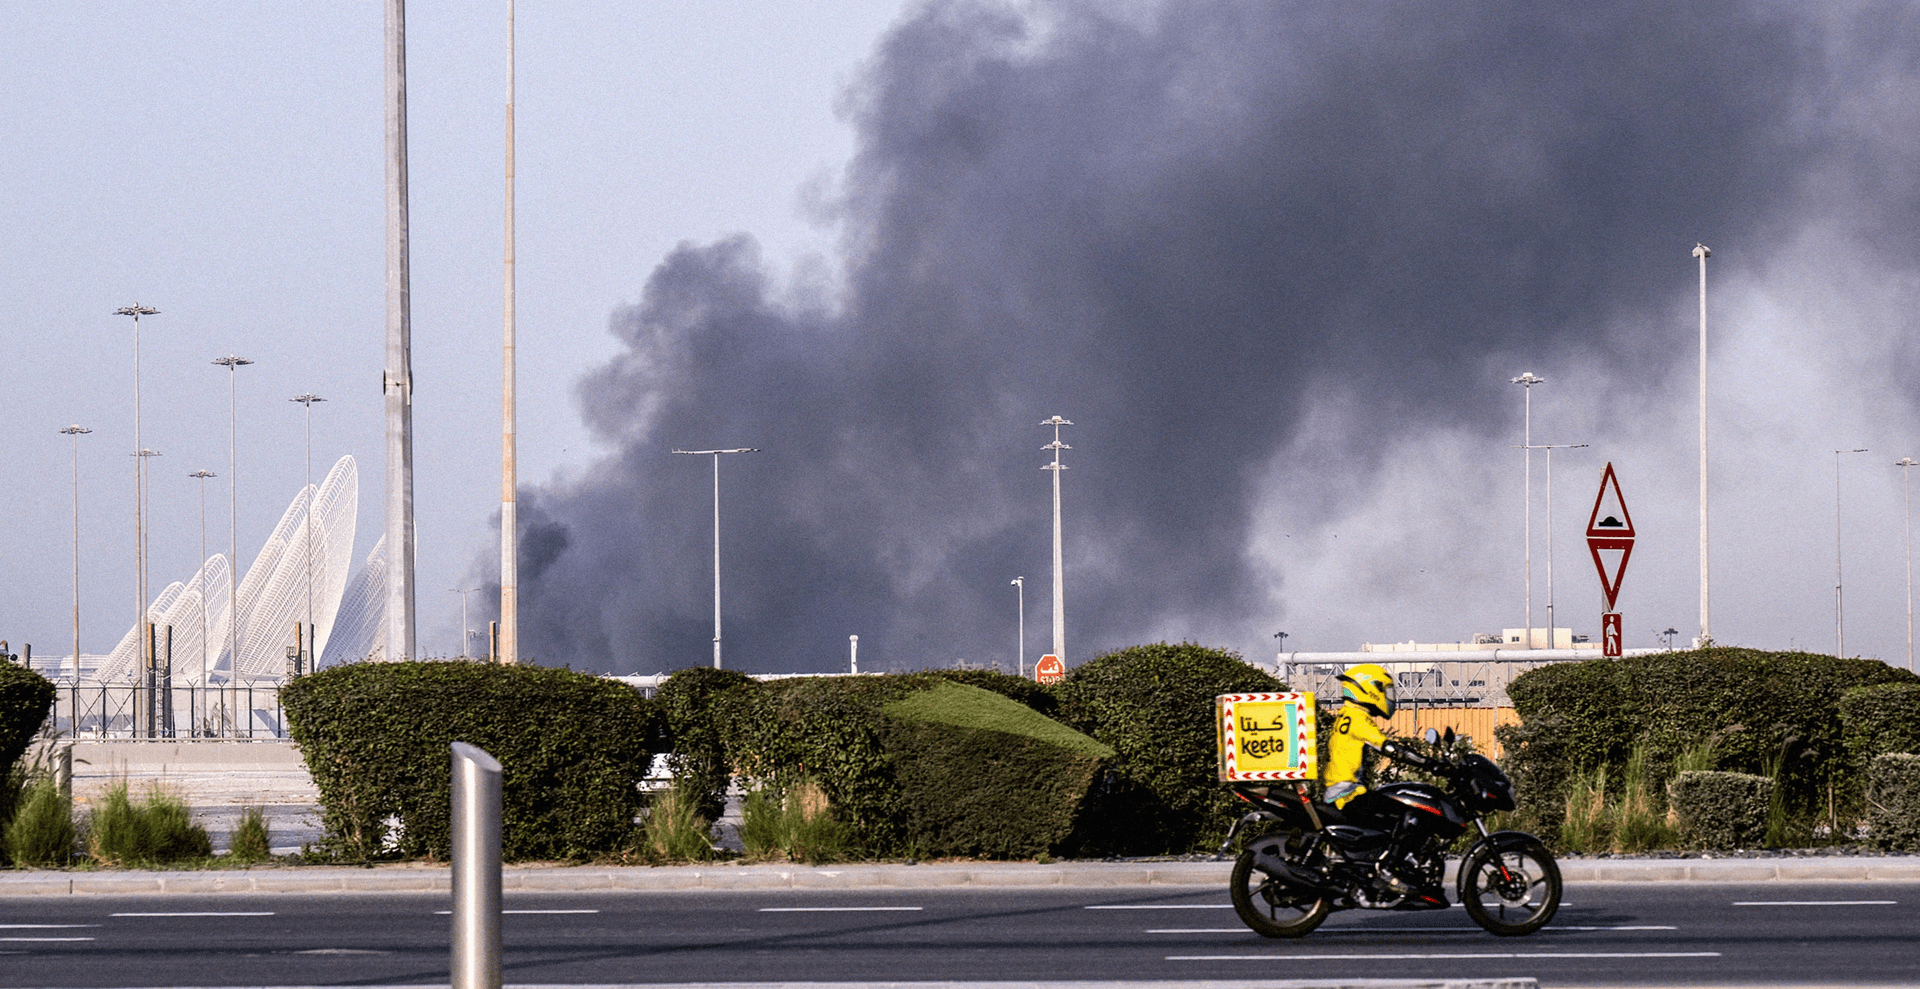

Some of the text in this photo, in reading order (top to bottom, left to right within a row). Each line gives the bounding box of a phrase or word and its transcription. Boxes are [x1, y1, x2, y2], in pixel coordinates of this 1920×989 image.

[1040, 661, 1059, 673] قف
[1240, 715, 1284, 736] كيتا
[1241, 736, 1284, 759] keeta
